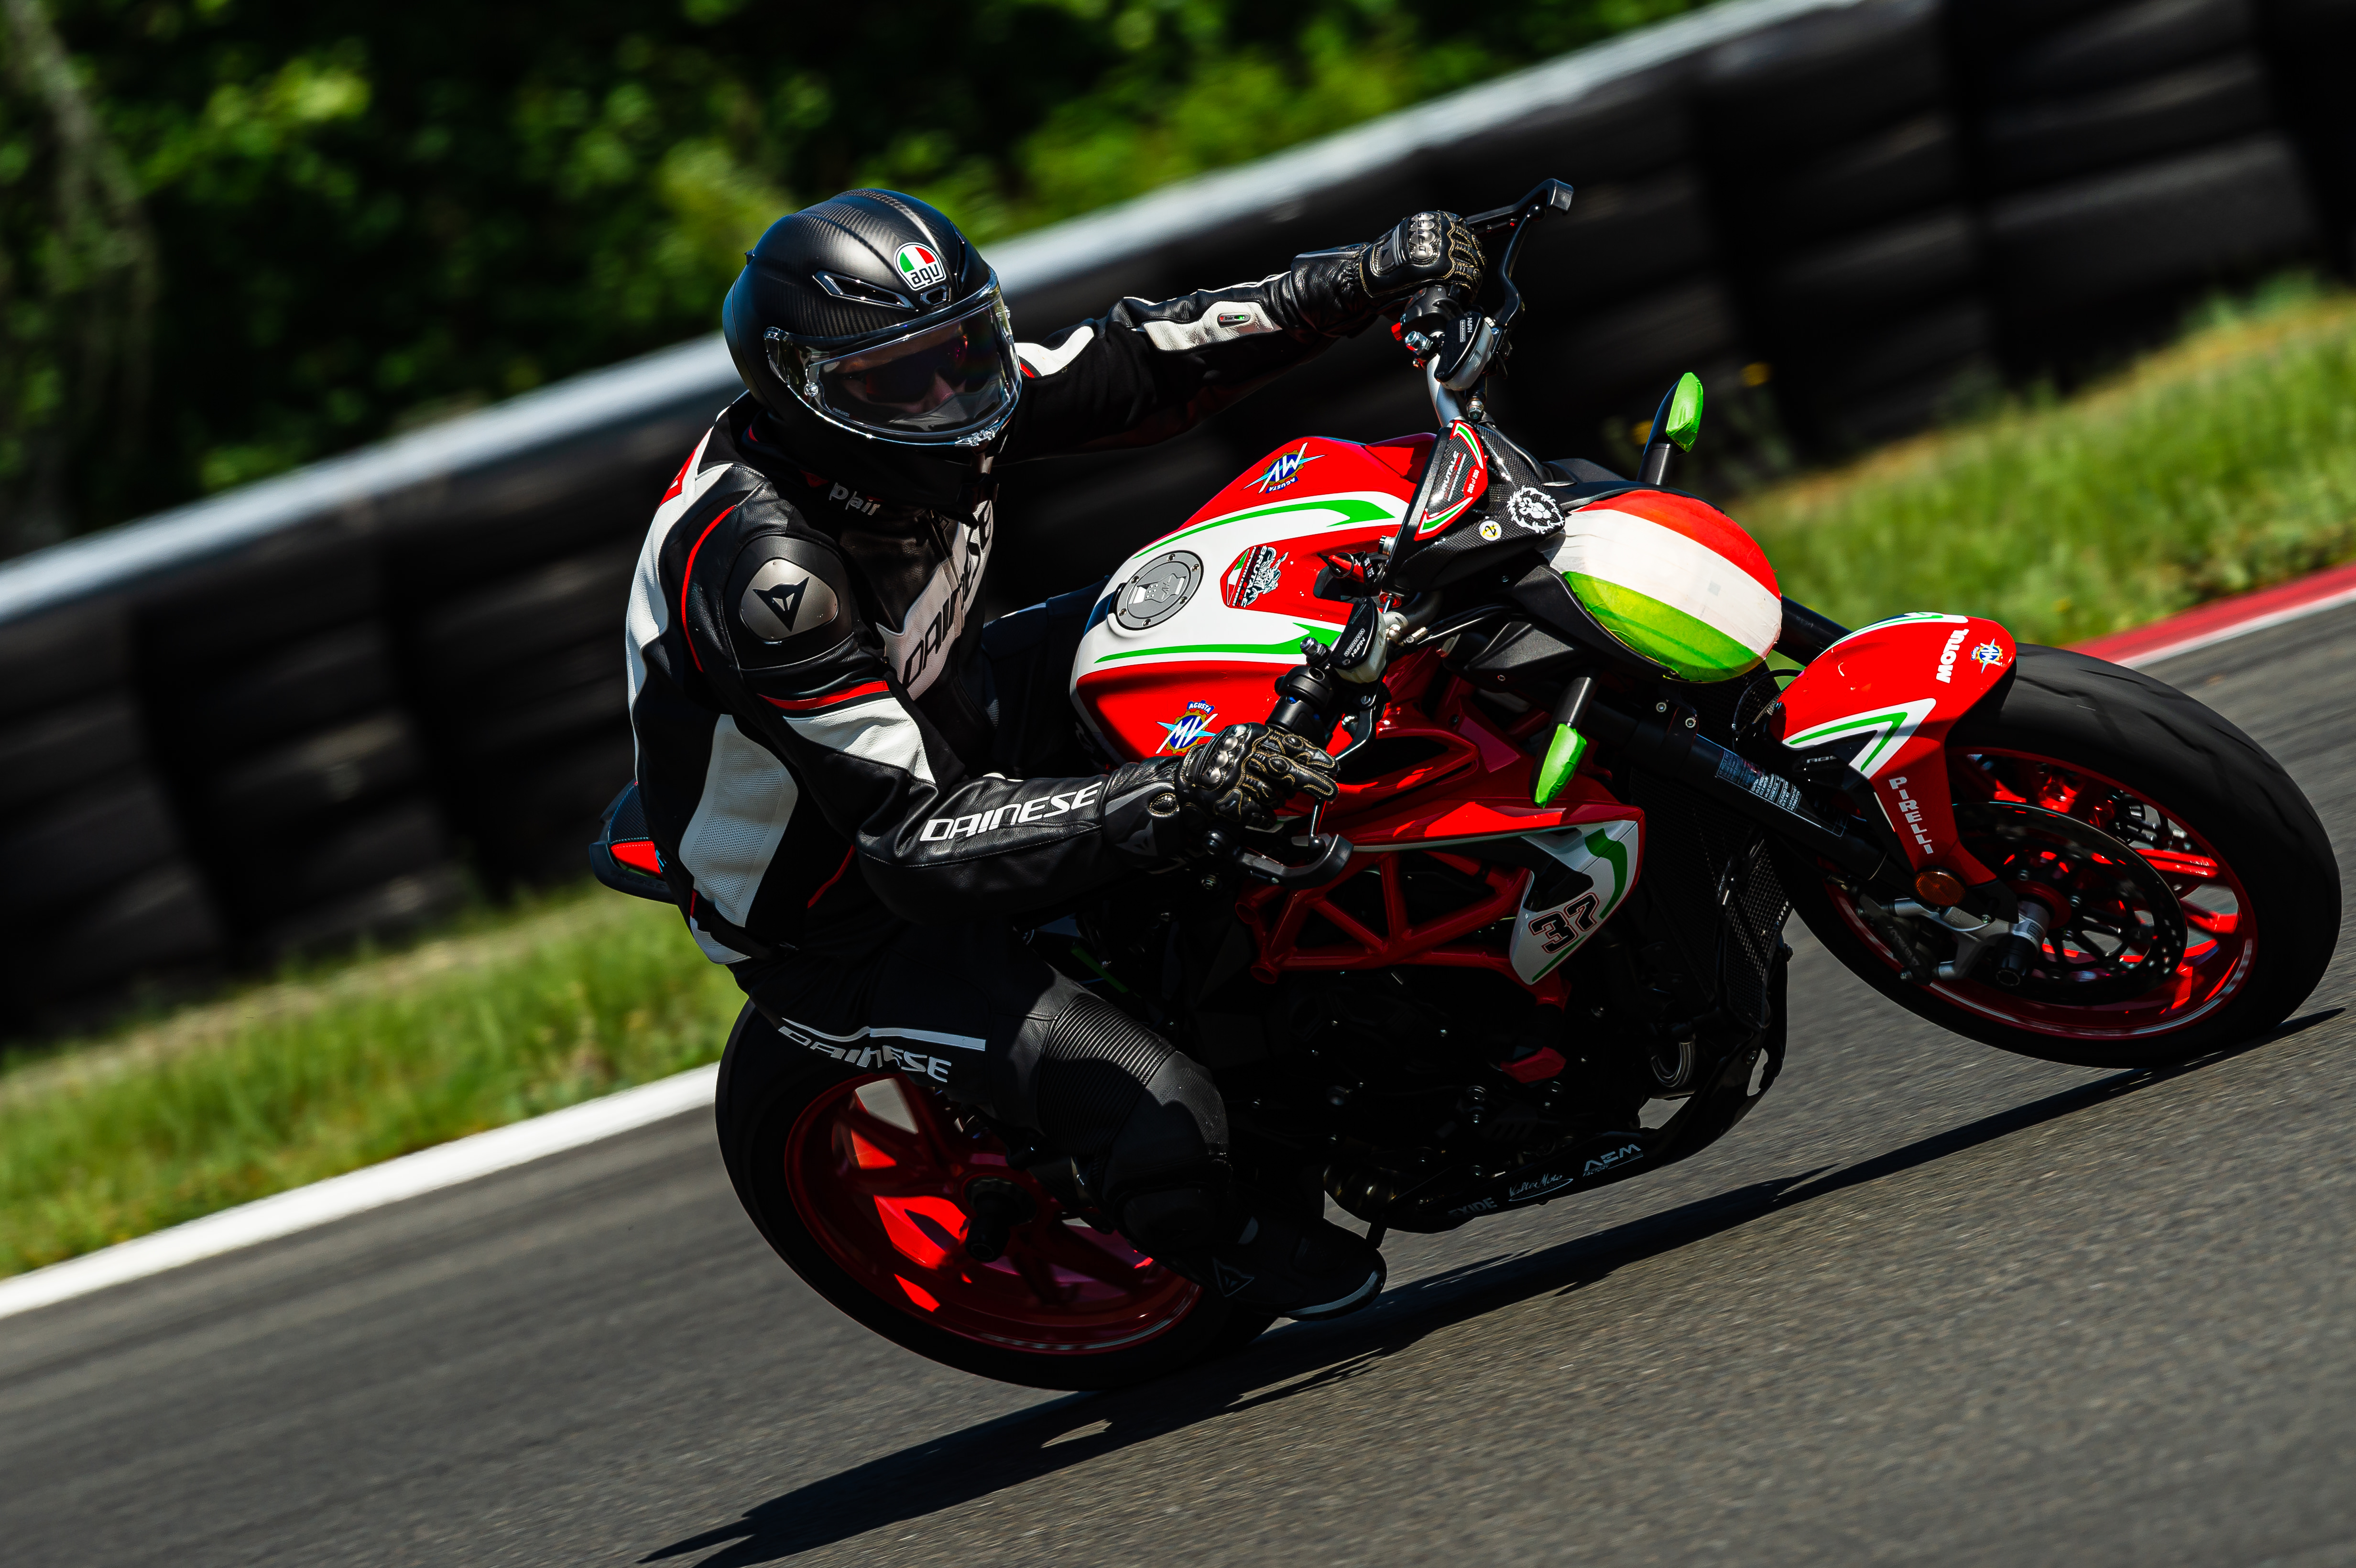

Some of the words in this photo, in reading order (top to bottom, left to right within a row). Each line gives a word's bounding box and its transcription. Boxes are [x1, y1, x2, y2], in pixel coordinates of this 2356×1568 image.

[911, 263, 942, 285] agv
[1268, 477, 1298, 493] AGUSTA
[1240, 545, 1267, 608] BRUTALE
[1344, 629, 1364, 655] WARNING
[1935, 628, 1970, 684] MOTUL
[1188, 702, 1213, 713] AGUSTA
[1155, 713, 1218, 754] MV
[919, 781, 1103, 842] DAINESE
[1888, 776, 1933, 854] PIRELLI
[1528, 892, 1601, 954] 37
[778, 1025, 952, 1083] DAINESE
[1582, 1164, 1610, 1177] FACTORY
[1447, 1197, 1498, 1217] EXIDE
